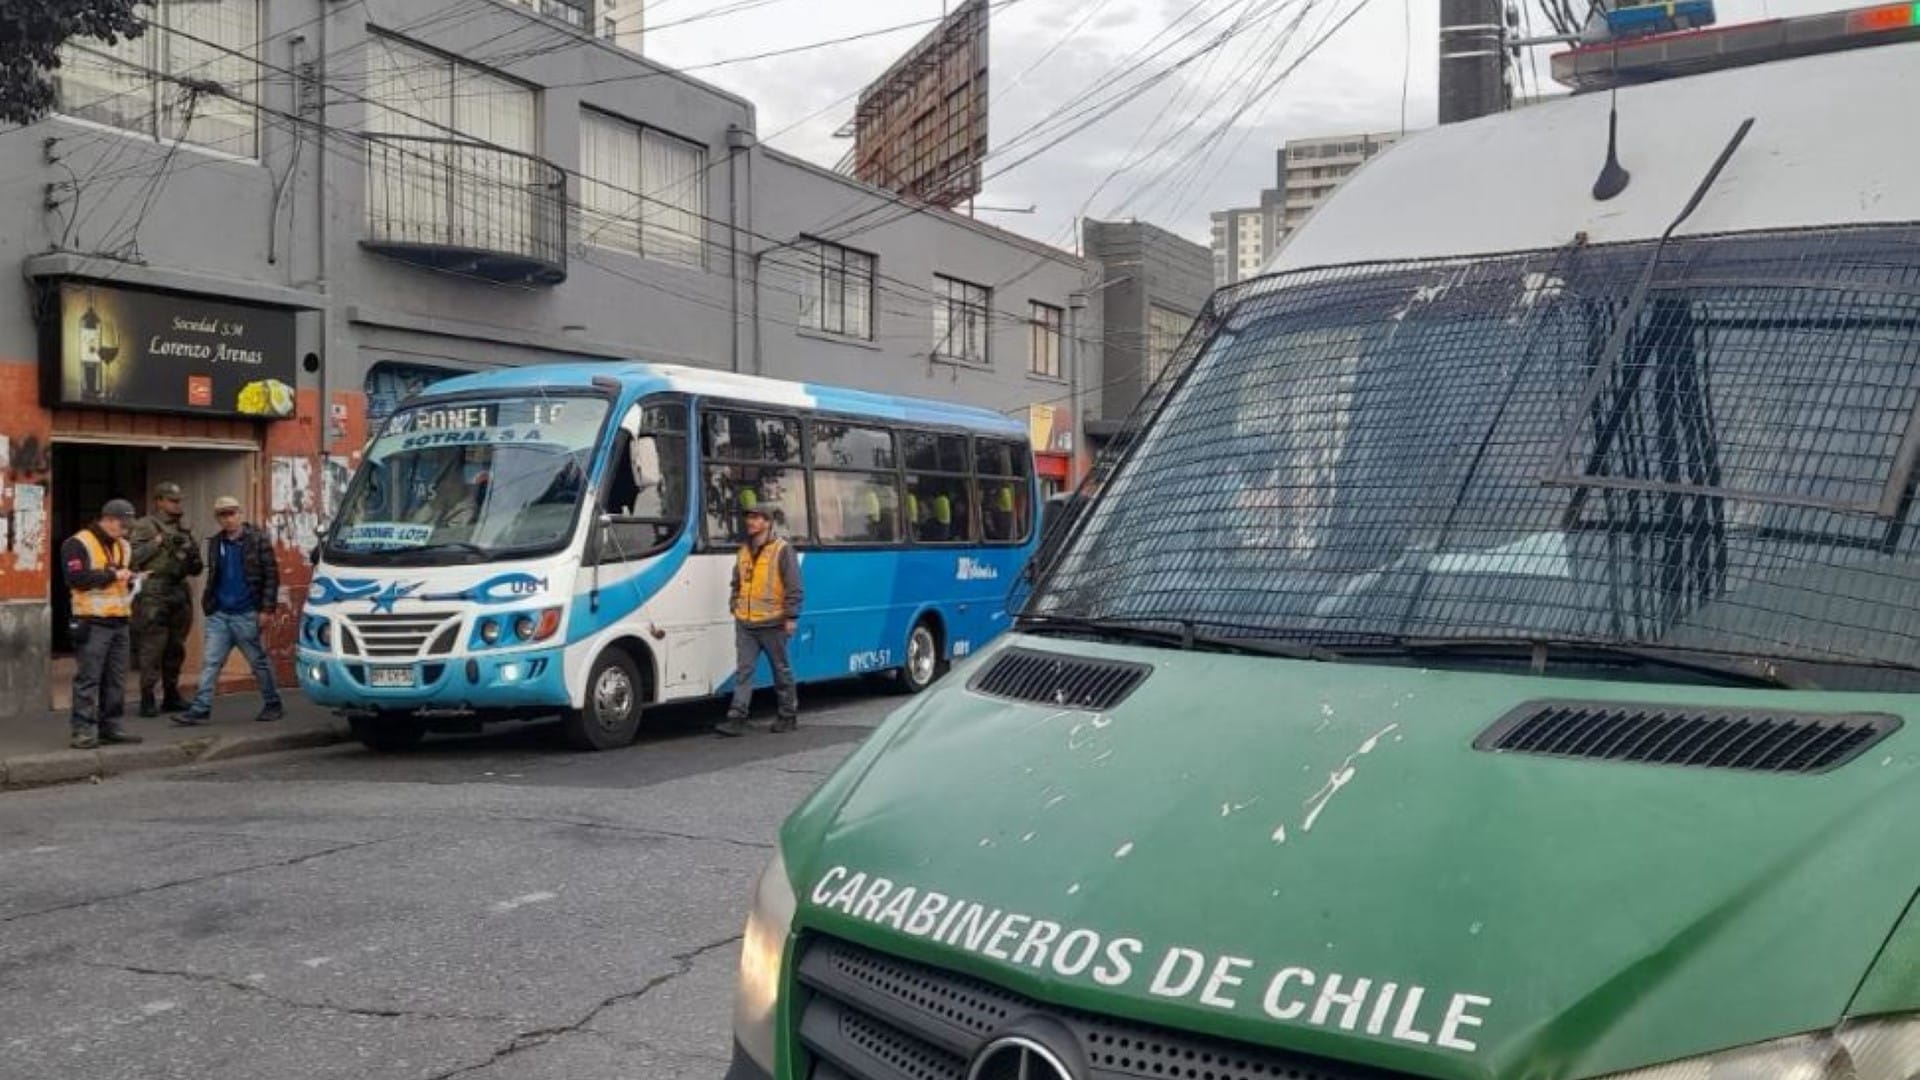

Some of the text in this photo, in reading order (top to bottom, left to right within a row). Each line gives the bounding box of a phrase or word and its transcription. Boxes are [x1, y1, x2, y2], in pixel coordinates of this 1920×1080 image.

[171, 316, 218, 333] Sociedad
[148, 336, 262, 364] Lorenzo Arenas
[402, 430, 490, 448] SOTRAL
[511, 577, 550, 594] 081
[811, 866, 1492, 1052] CARABINEROS DE CHILE
